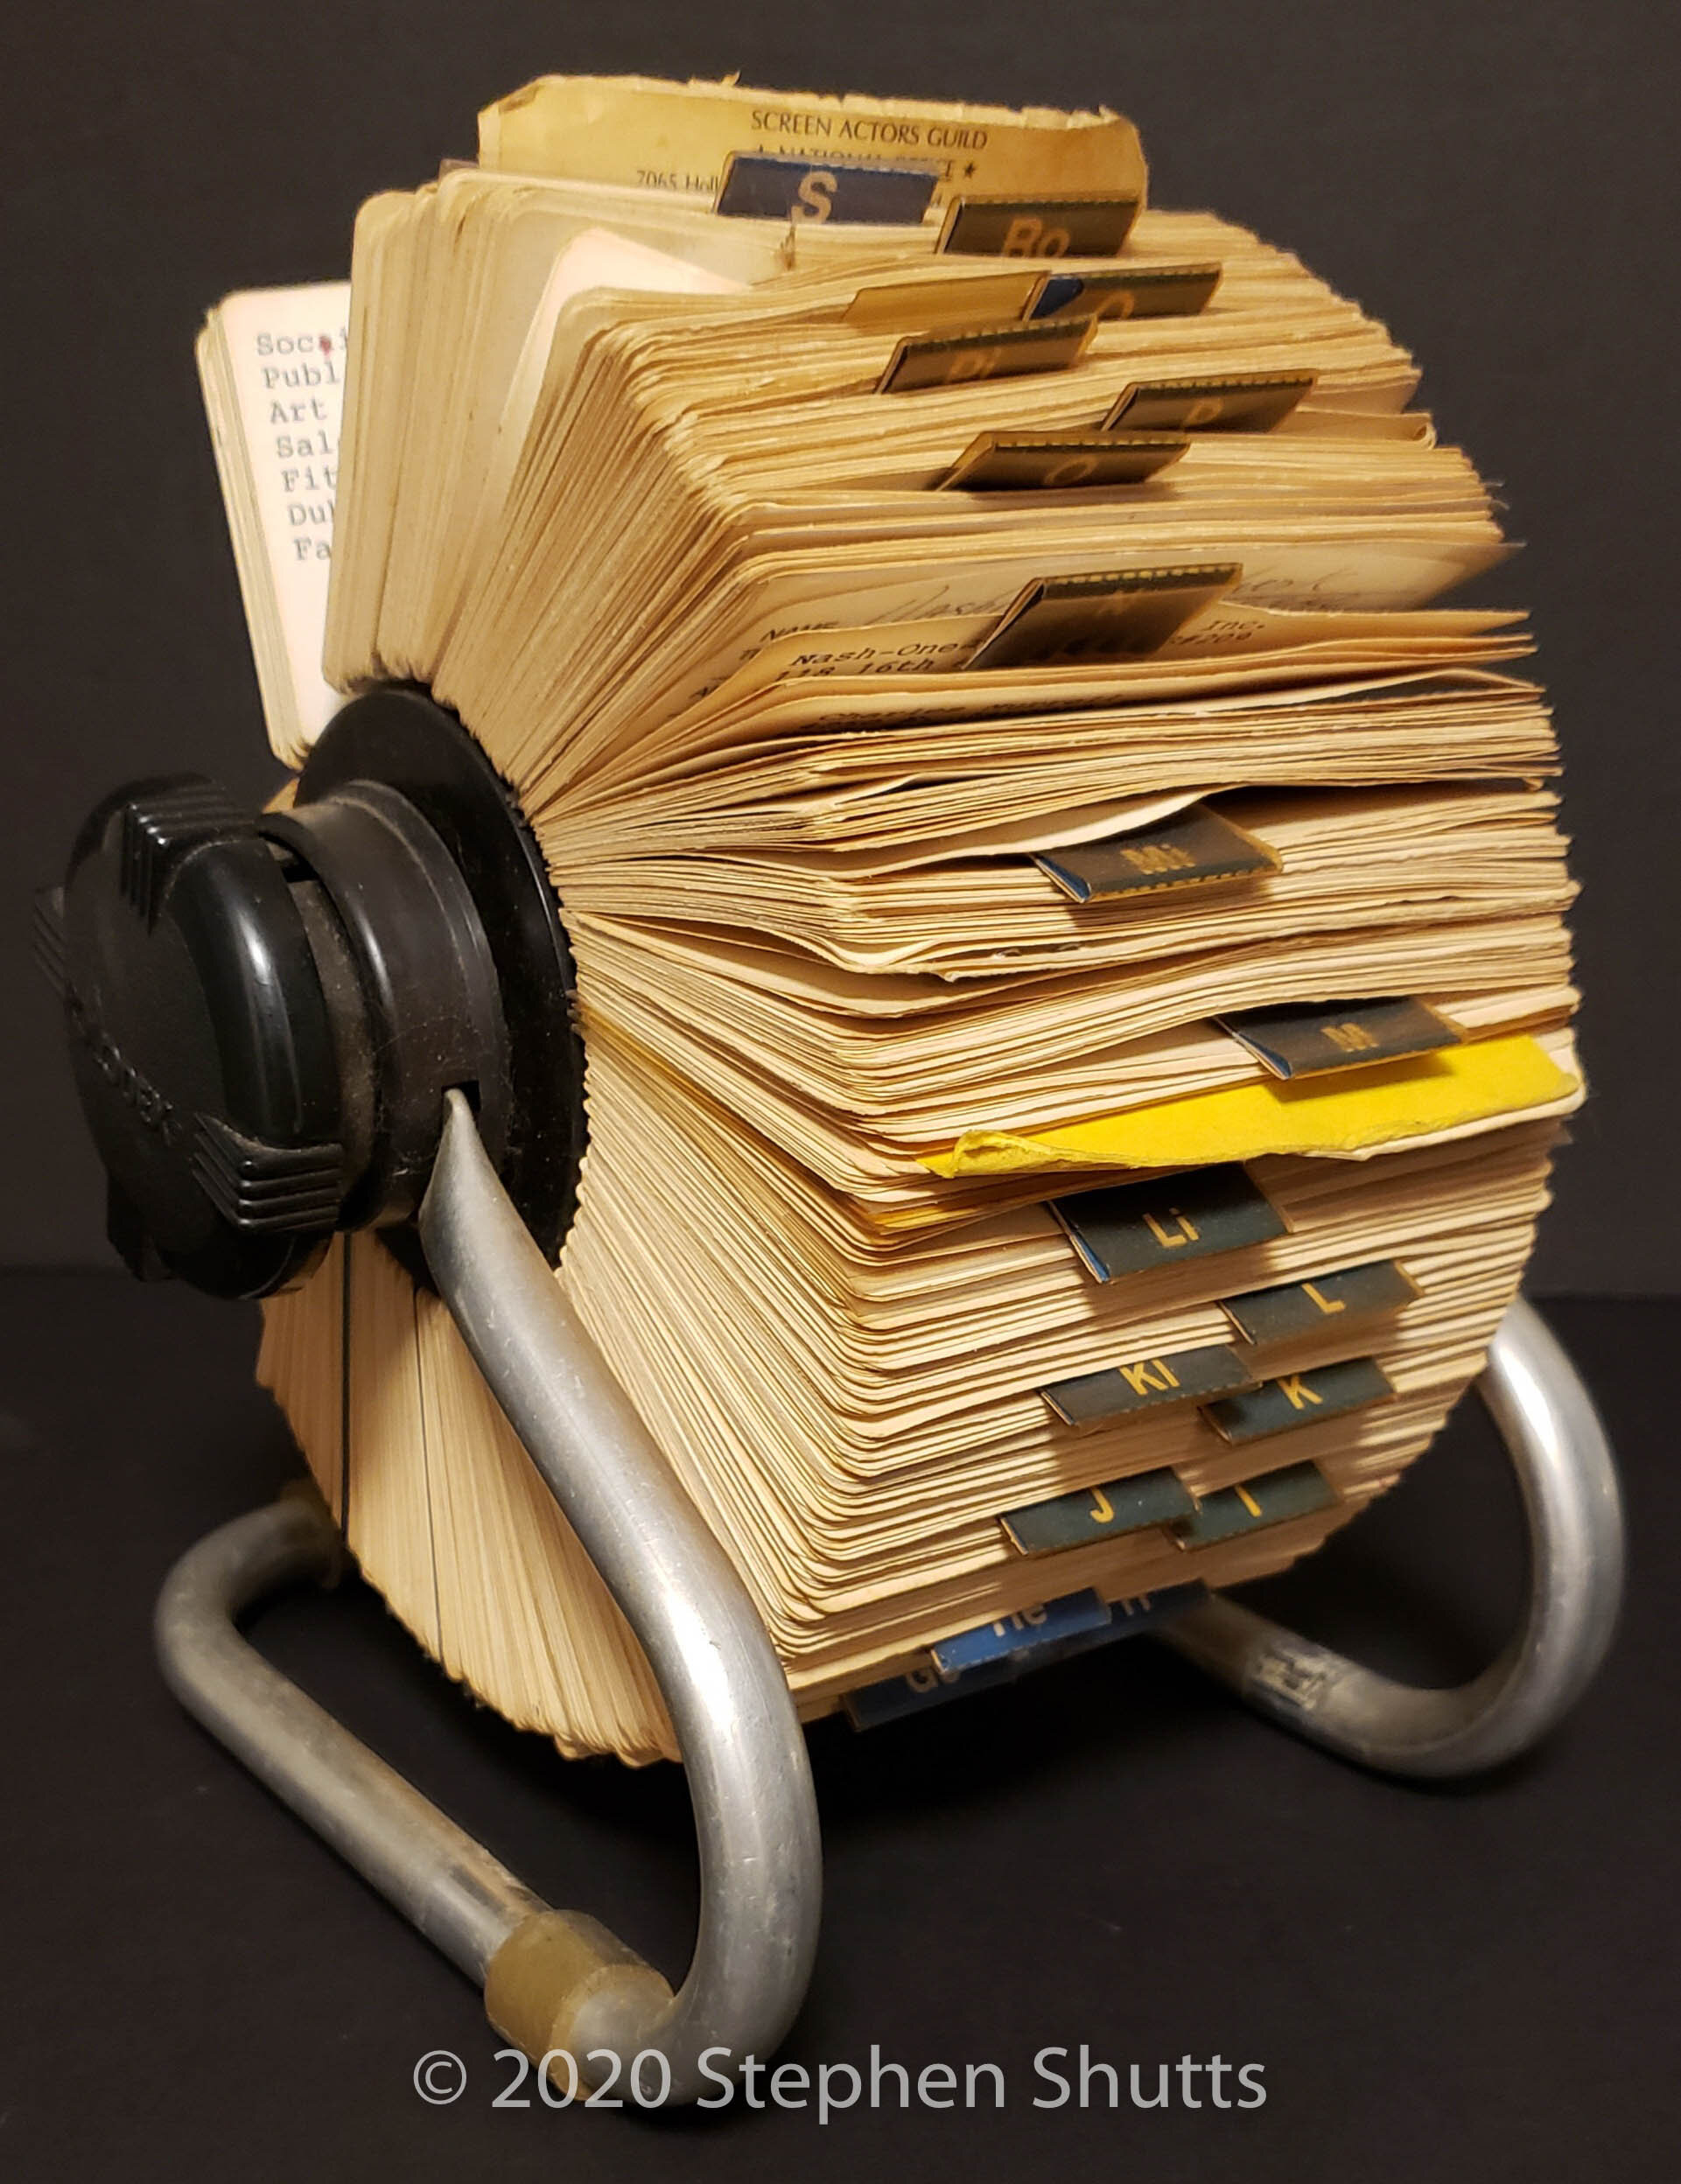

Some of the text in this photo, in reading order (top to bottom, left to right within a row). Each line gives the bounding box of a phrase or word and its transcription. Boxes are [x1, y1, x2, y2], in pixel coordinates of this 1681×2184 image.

[752, 109, 988, 150] SCREEN ACTORS GUILD
[790, 172, 838, 225] S
[263, 360, 340, 389] Publ
[270, 396, 327, 424] Art
[276, 430, 335, 458] Sal
[1142, 1207, 1201, 1249] Li
[1301, 1282, 1347, 1313] L
[1276, 1374, 1324, 1410] K
[1089, 1486, 1115, 1524] J
[1235, 1485, 1263, 1518] I
